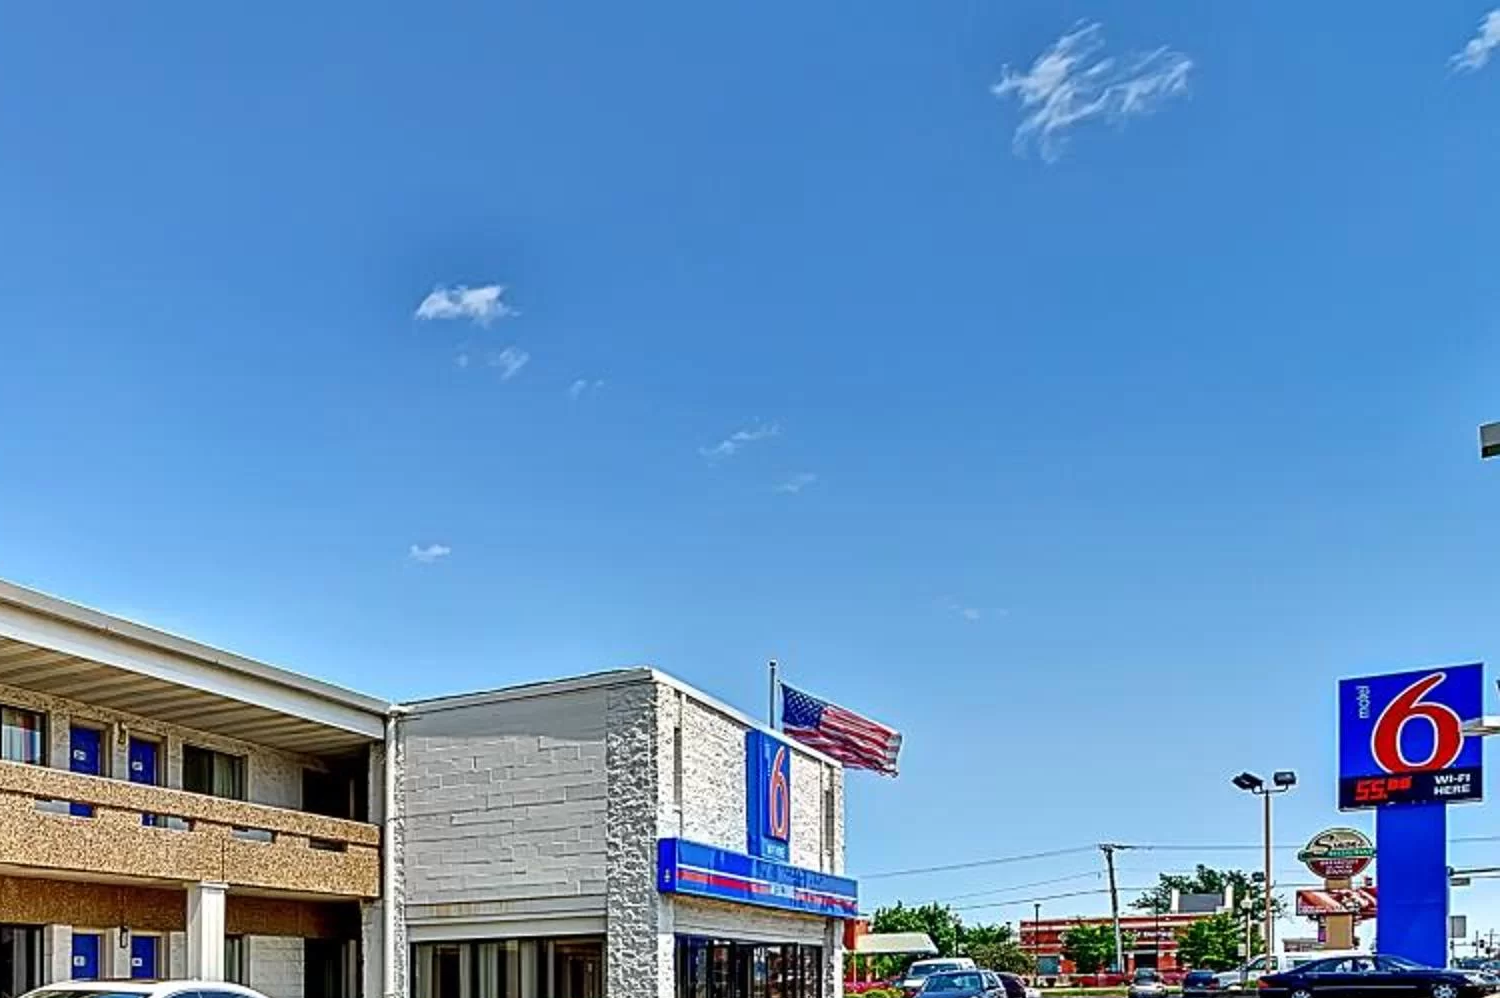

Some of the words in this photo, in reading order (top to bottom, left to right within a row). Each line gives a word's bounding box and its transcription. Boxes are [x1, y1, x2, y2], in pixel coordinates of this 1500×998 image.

[1371, 672, 1464, 773] 6
[770, 746, 789, 840] 6
[1433, 773, 1471, 784] WI-FI
[1433, 784, 1471, 795] HERE
